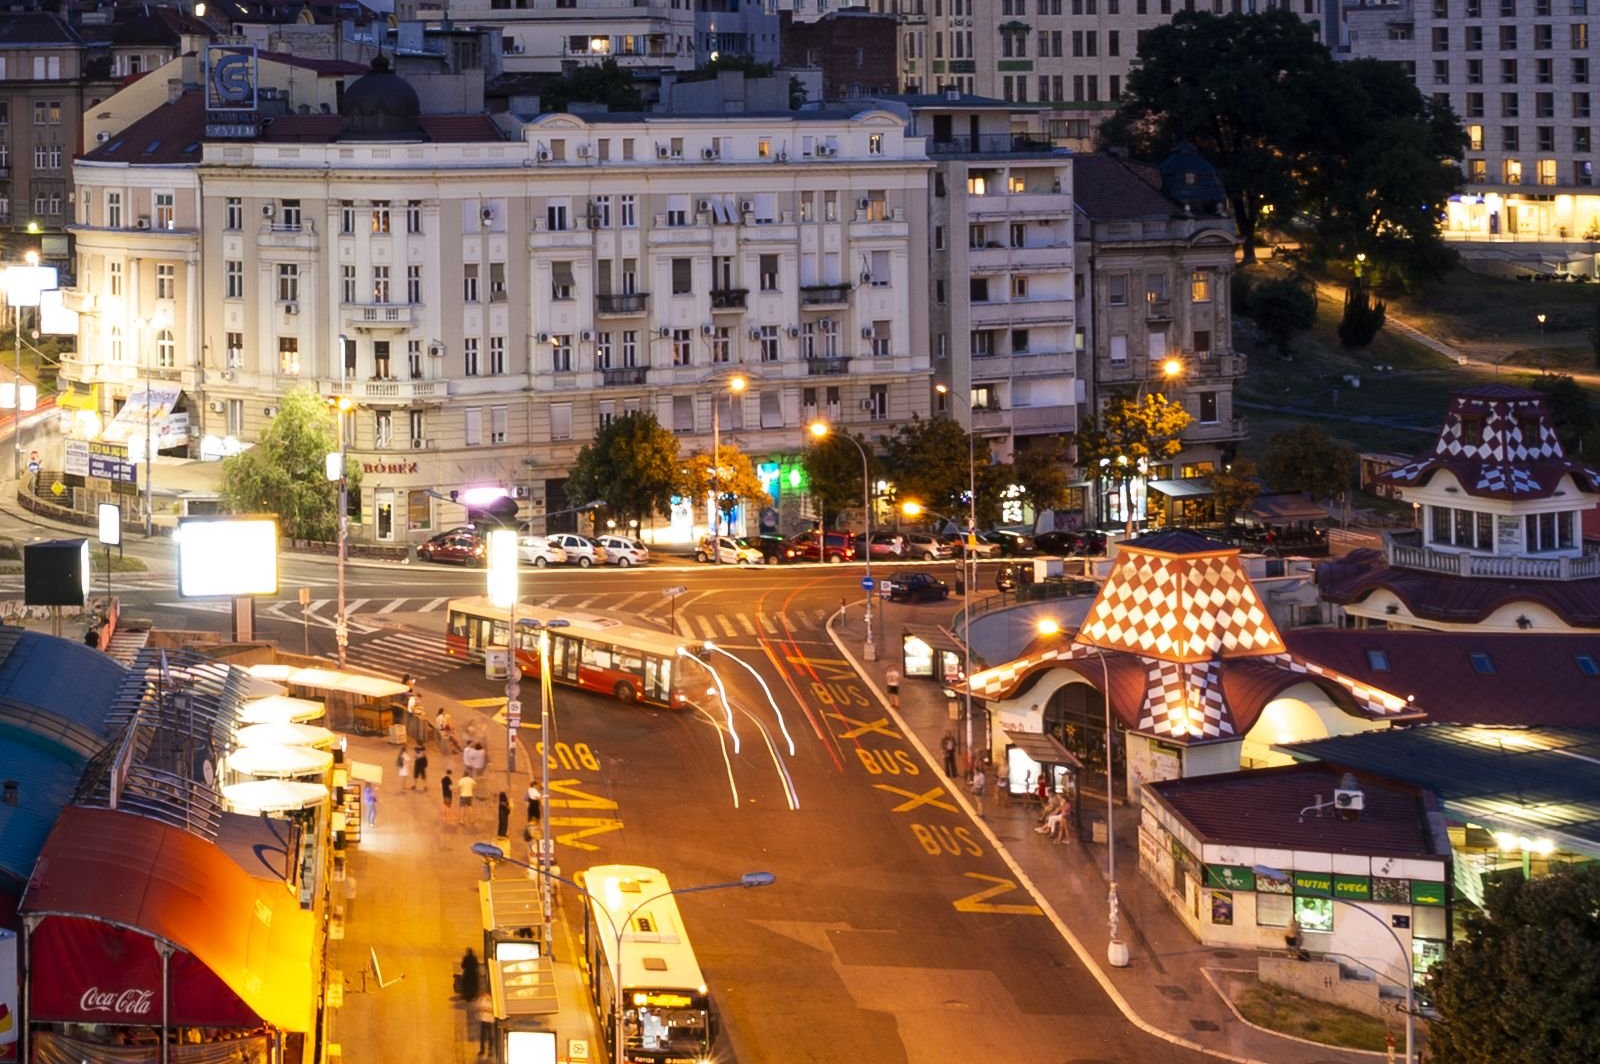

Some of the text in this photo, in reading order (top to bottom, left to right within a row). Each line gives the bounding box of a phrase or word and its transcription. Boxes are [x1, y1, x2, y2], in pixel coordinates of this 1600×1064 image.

[811, 681, 871, 707] BUS
[536, 741, 600, 771] BUS
[855, 748, 919, 776] BUS
[910, 824, 984, 857] BUS
[80, 986, 155, 1015] Coca-Cola
